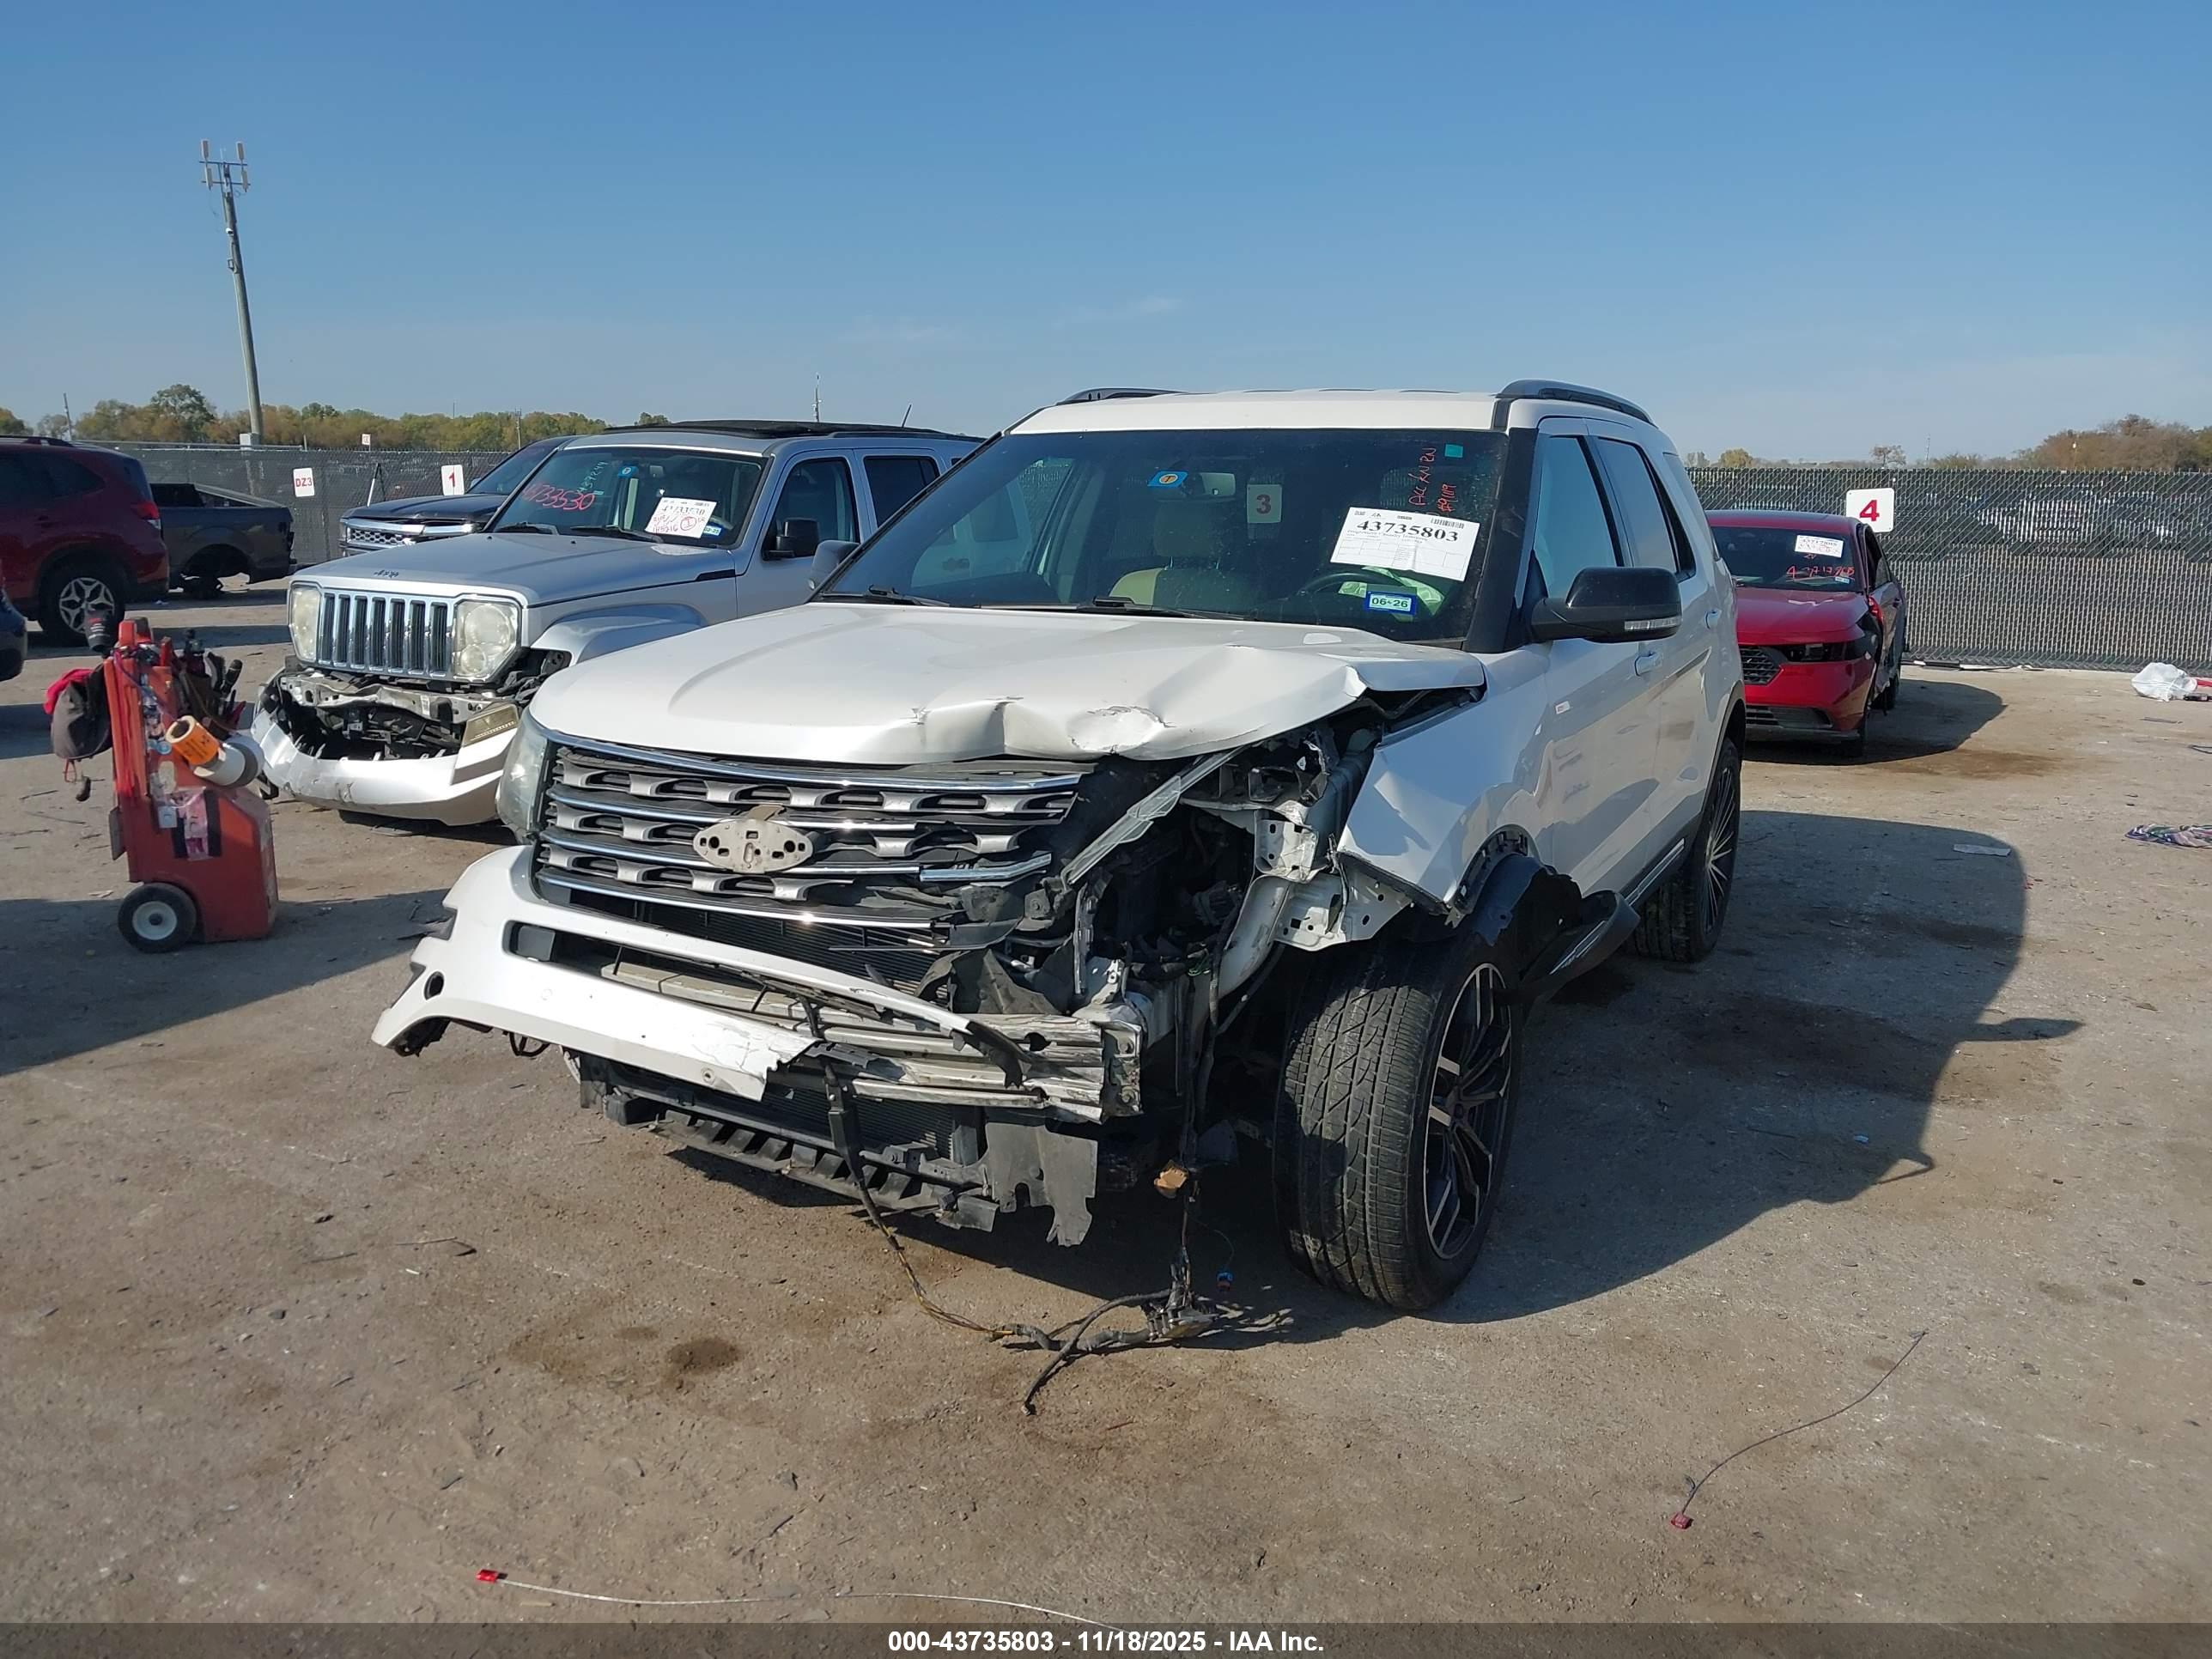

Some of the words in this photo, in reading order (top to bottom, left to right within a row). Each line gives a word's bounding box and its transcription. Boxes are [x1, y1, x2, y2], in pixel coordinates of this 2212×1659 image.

[295, 477, 313, 488] DZ3
[448, 472, 456, 488] 1
[1256, 494, 1272, 514] 3
[1859, 499, 1880, 522] 4
[1357, 520, 1459, 543] 43735803
[1371, 597, 1409, 608] 06-26
